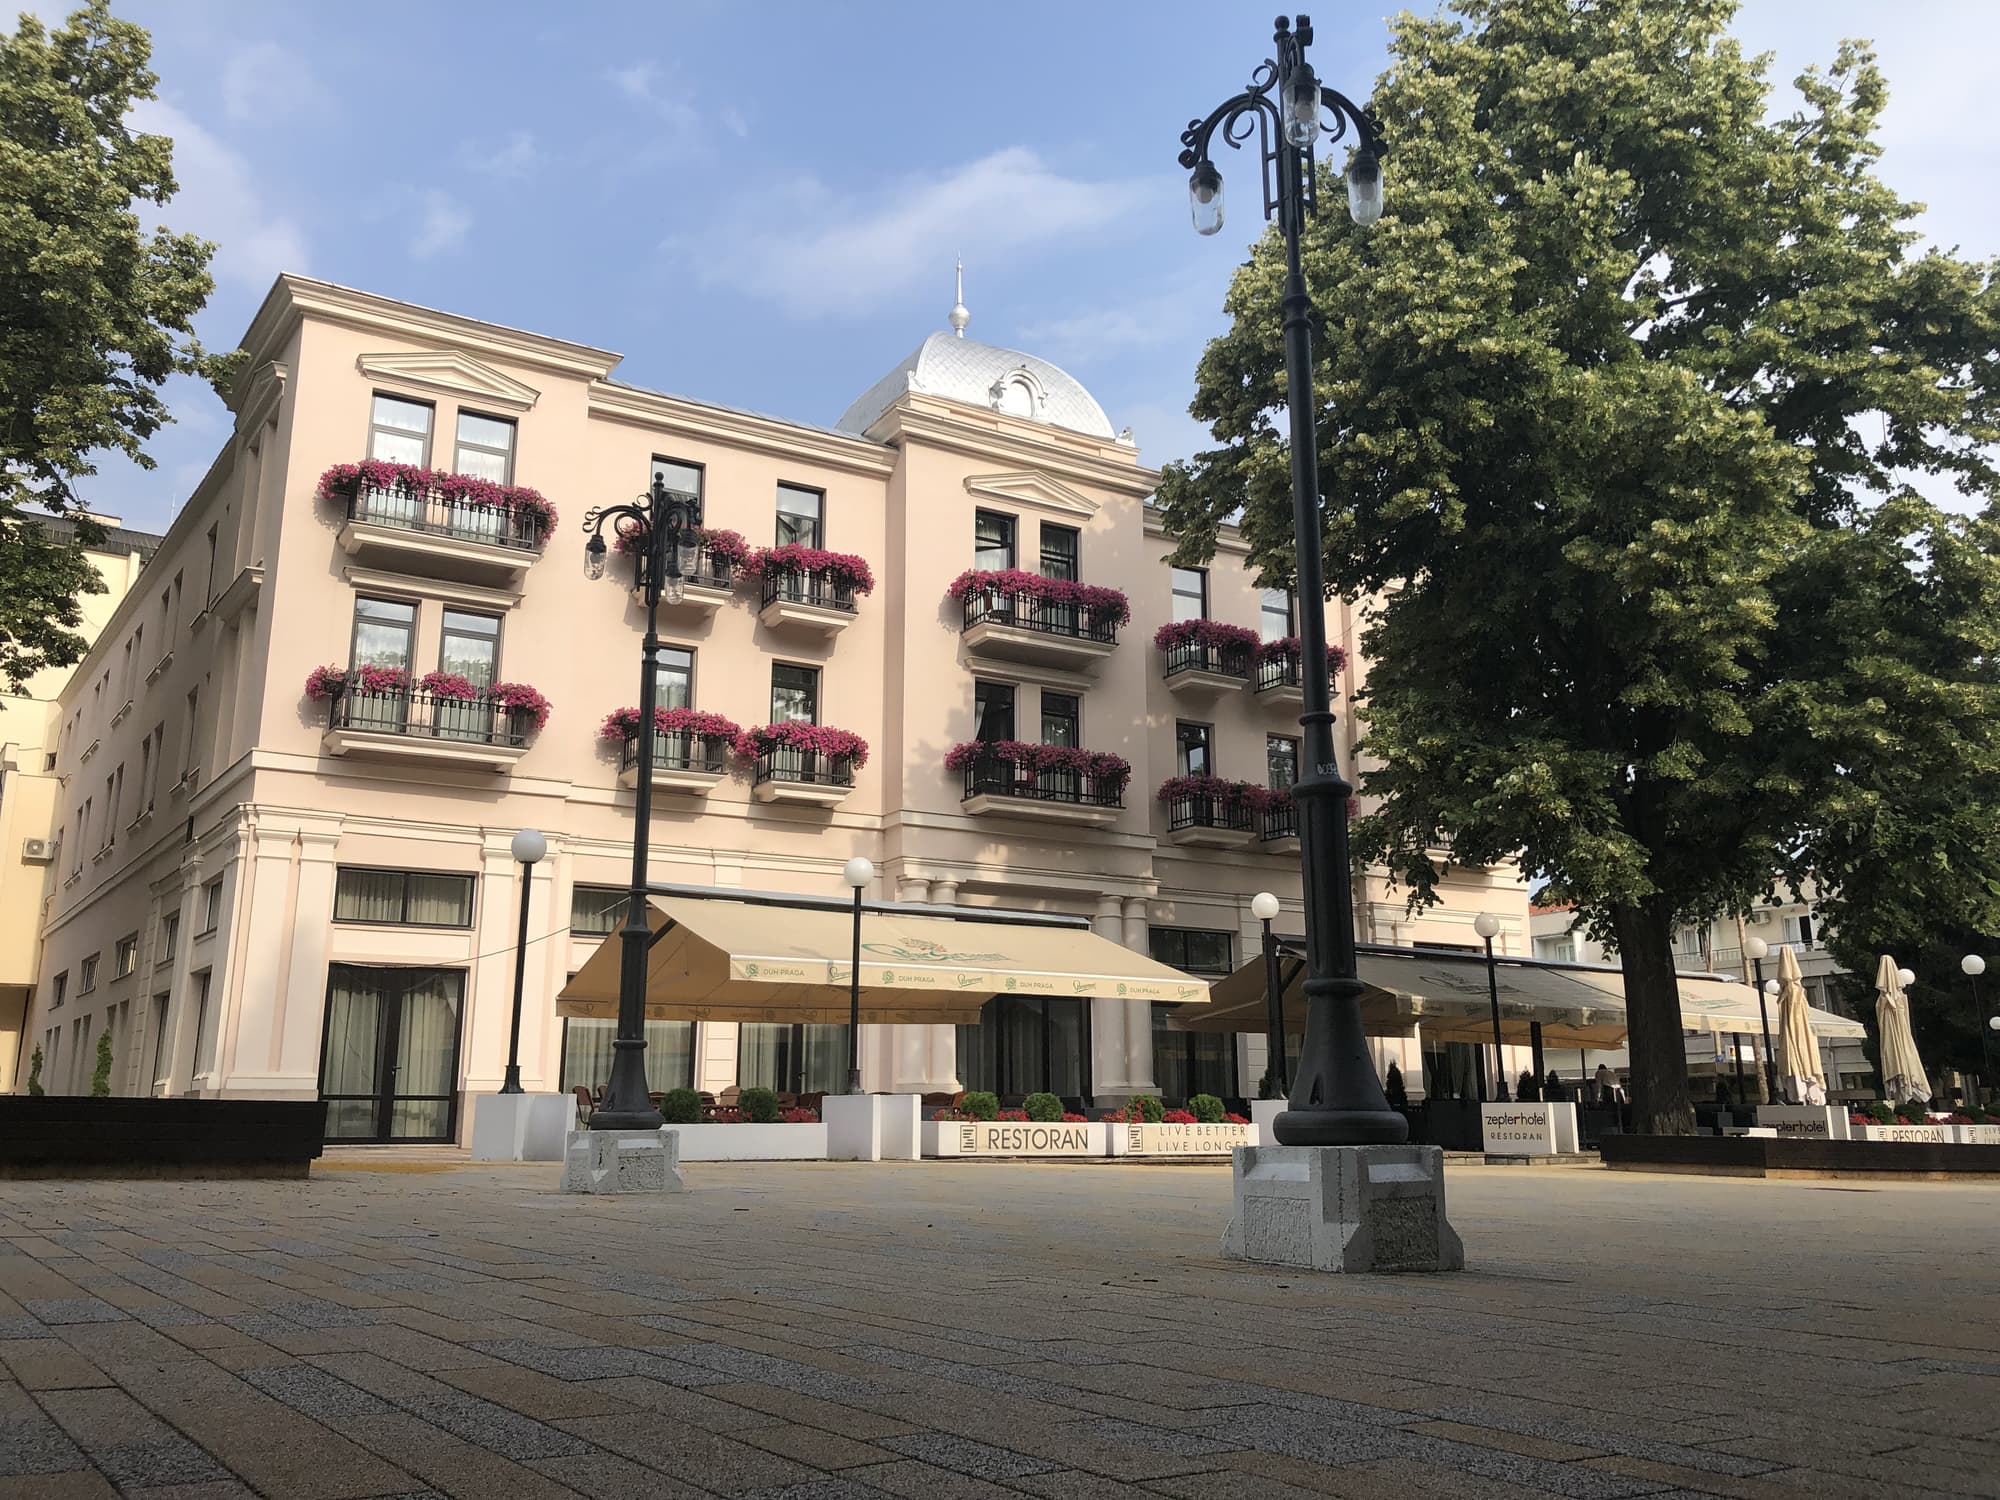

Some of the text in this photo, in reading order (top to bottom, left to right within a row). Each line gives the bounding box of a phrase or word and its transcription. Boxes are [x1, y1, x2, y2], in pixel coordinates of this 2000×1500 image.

[1160, 1126, 1246, 1136] LIVE BETTER
[988, 1128, 1088, 1150] RESTORAN
[1491, 1132, 1543, 1141] RESTORAN
[1157, 1141, 1188, 1152] LIVE
